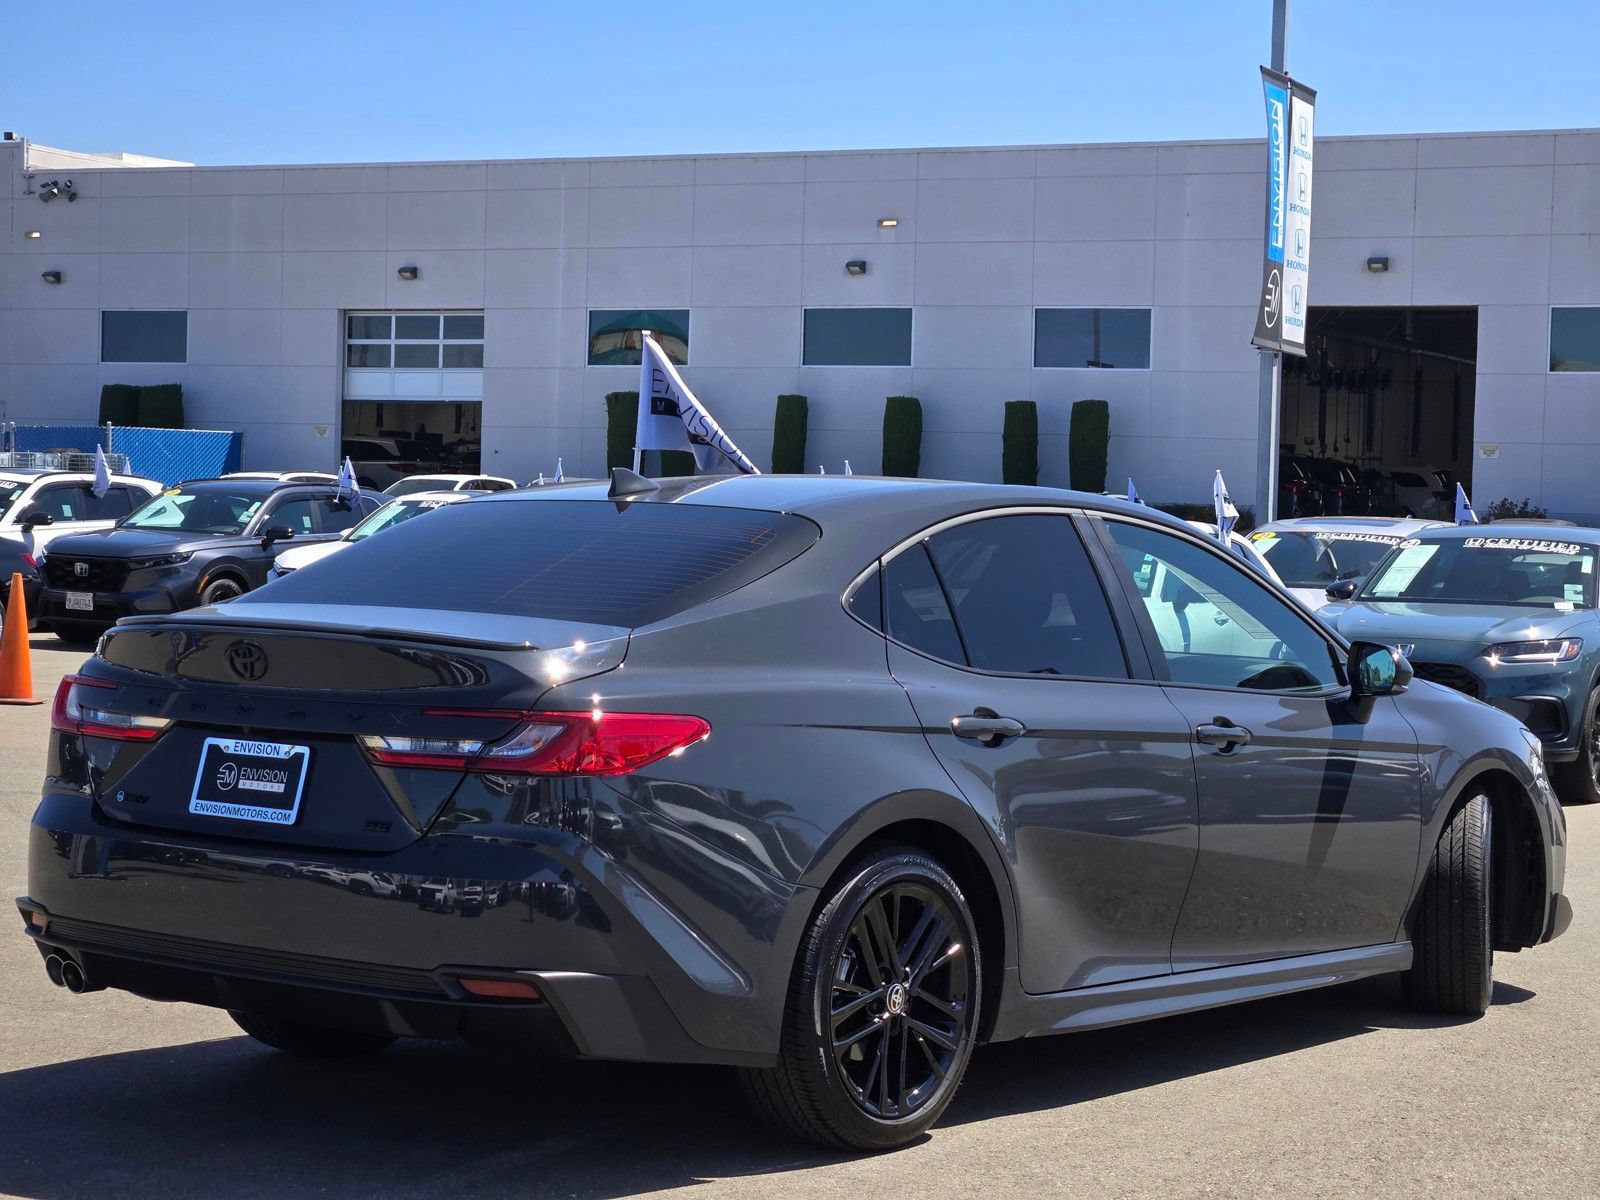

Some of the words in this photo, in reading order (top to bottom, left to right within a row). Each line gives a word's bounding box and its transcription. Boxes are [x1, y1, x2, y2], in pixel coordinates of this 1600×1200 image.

[1293, 146, 1312, 161] HONDA
[1269, 98, 1281, 249] ENVISION
[1289, 203, 1310, 217] HONDA
[1286, 259, 1308, 273] HONDA
[1285, 316, 1304, 328] HONDA
[1485, 538, 1580, 551] CERTIFIED
[233, 741, 281, 756] ENVISION
[239, 767, 289, 783] ENVISION
[242, 782, 281, 791] MOTORS
[194, 802, 292, 822] ENVISIONMOTORS.COM
